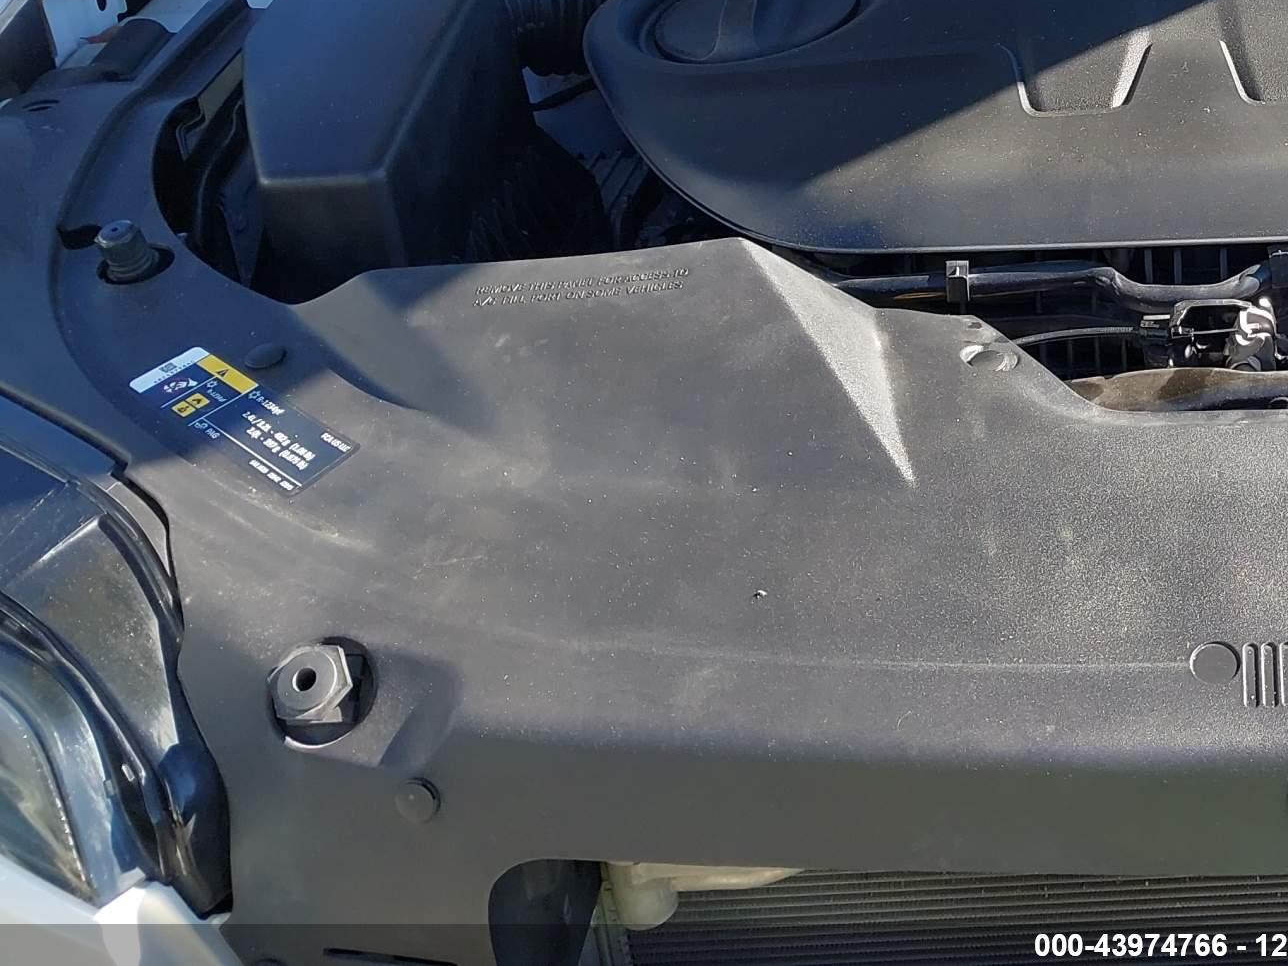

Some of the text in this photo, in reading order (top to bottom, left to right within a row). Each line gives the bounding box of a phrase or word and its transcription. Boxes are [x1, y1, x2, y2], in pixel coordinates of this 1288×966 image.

[476, 268, 689, 294] REMOVE THIS PANEL FOR ACCESS TO
[502, 294, 526, 305] FILL
[530, 292, 562, 302] PORT
[565, 290, 585, 299] ON
[585, 287, 621, 298] SOME
